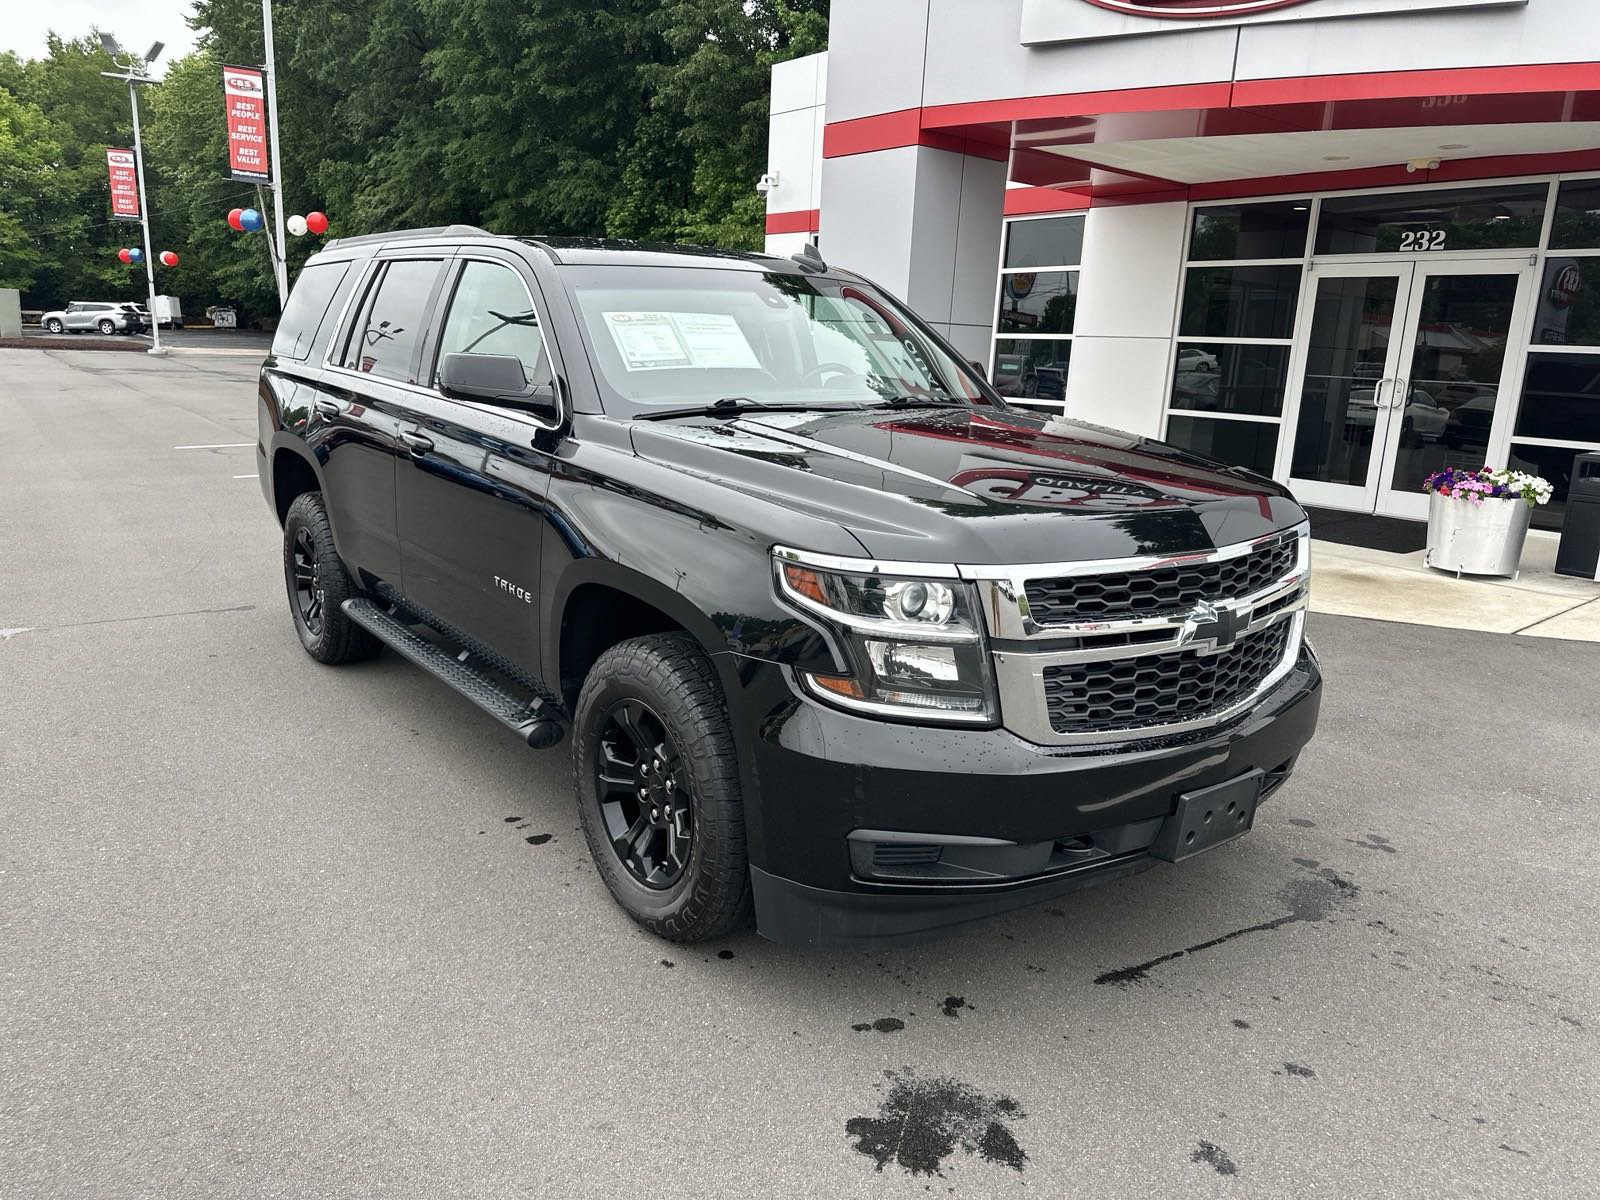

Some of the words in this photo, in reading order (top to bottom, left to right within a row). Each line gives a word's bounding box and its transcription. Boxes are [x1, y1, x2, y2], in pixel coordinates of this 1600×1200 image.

[230, 79, 251, 87] CBS
[236, 102, 256, 111] BEST
[231, 109, 260, 120] PEOPLE
[237, 125, 257, 134] BEST
[231, 132, 263, 143] SERVICE
[239, 147, 258, 157] BEST
[236, 155, 260, 165] VALUE
[1400, 230, 1446, 251] 232
[493, 575, 532, 604] TAHOE
